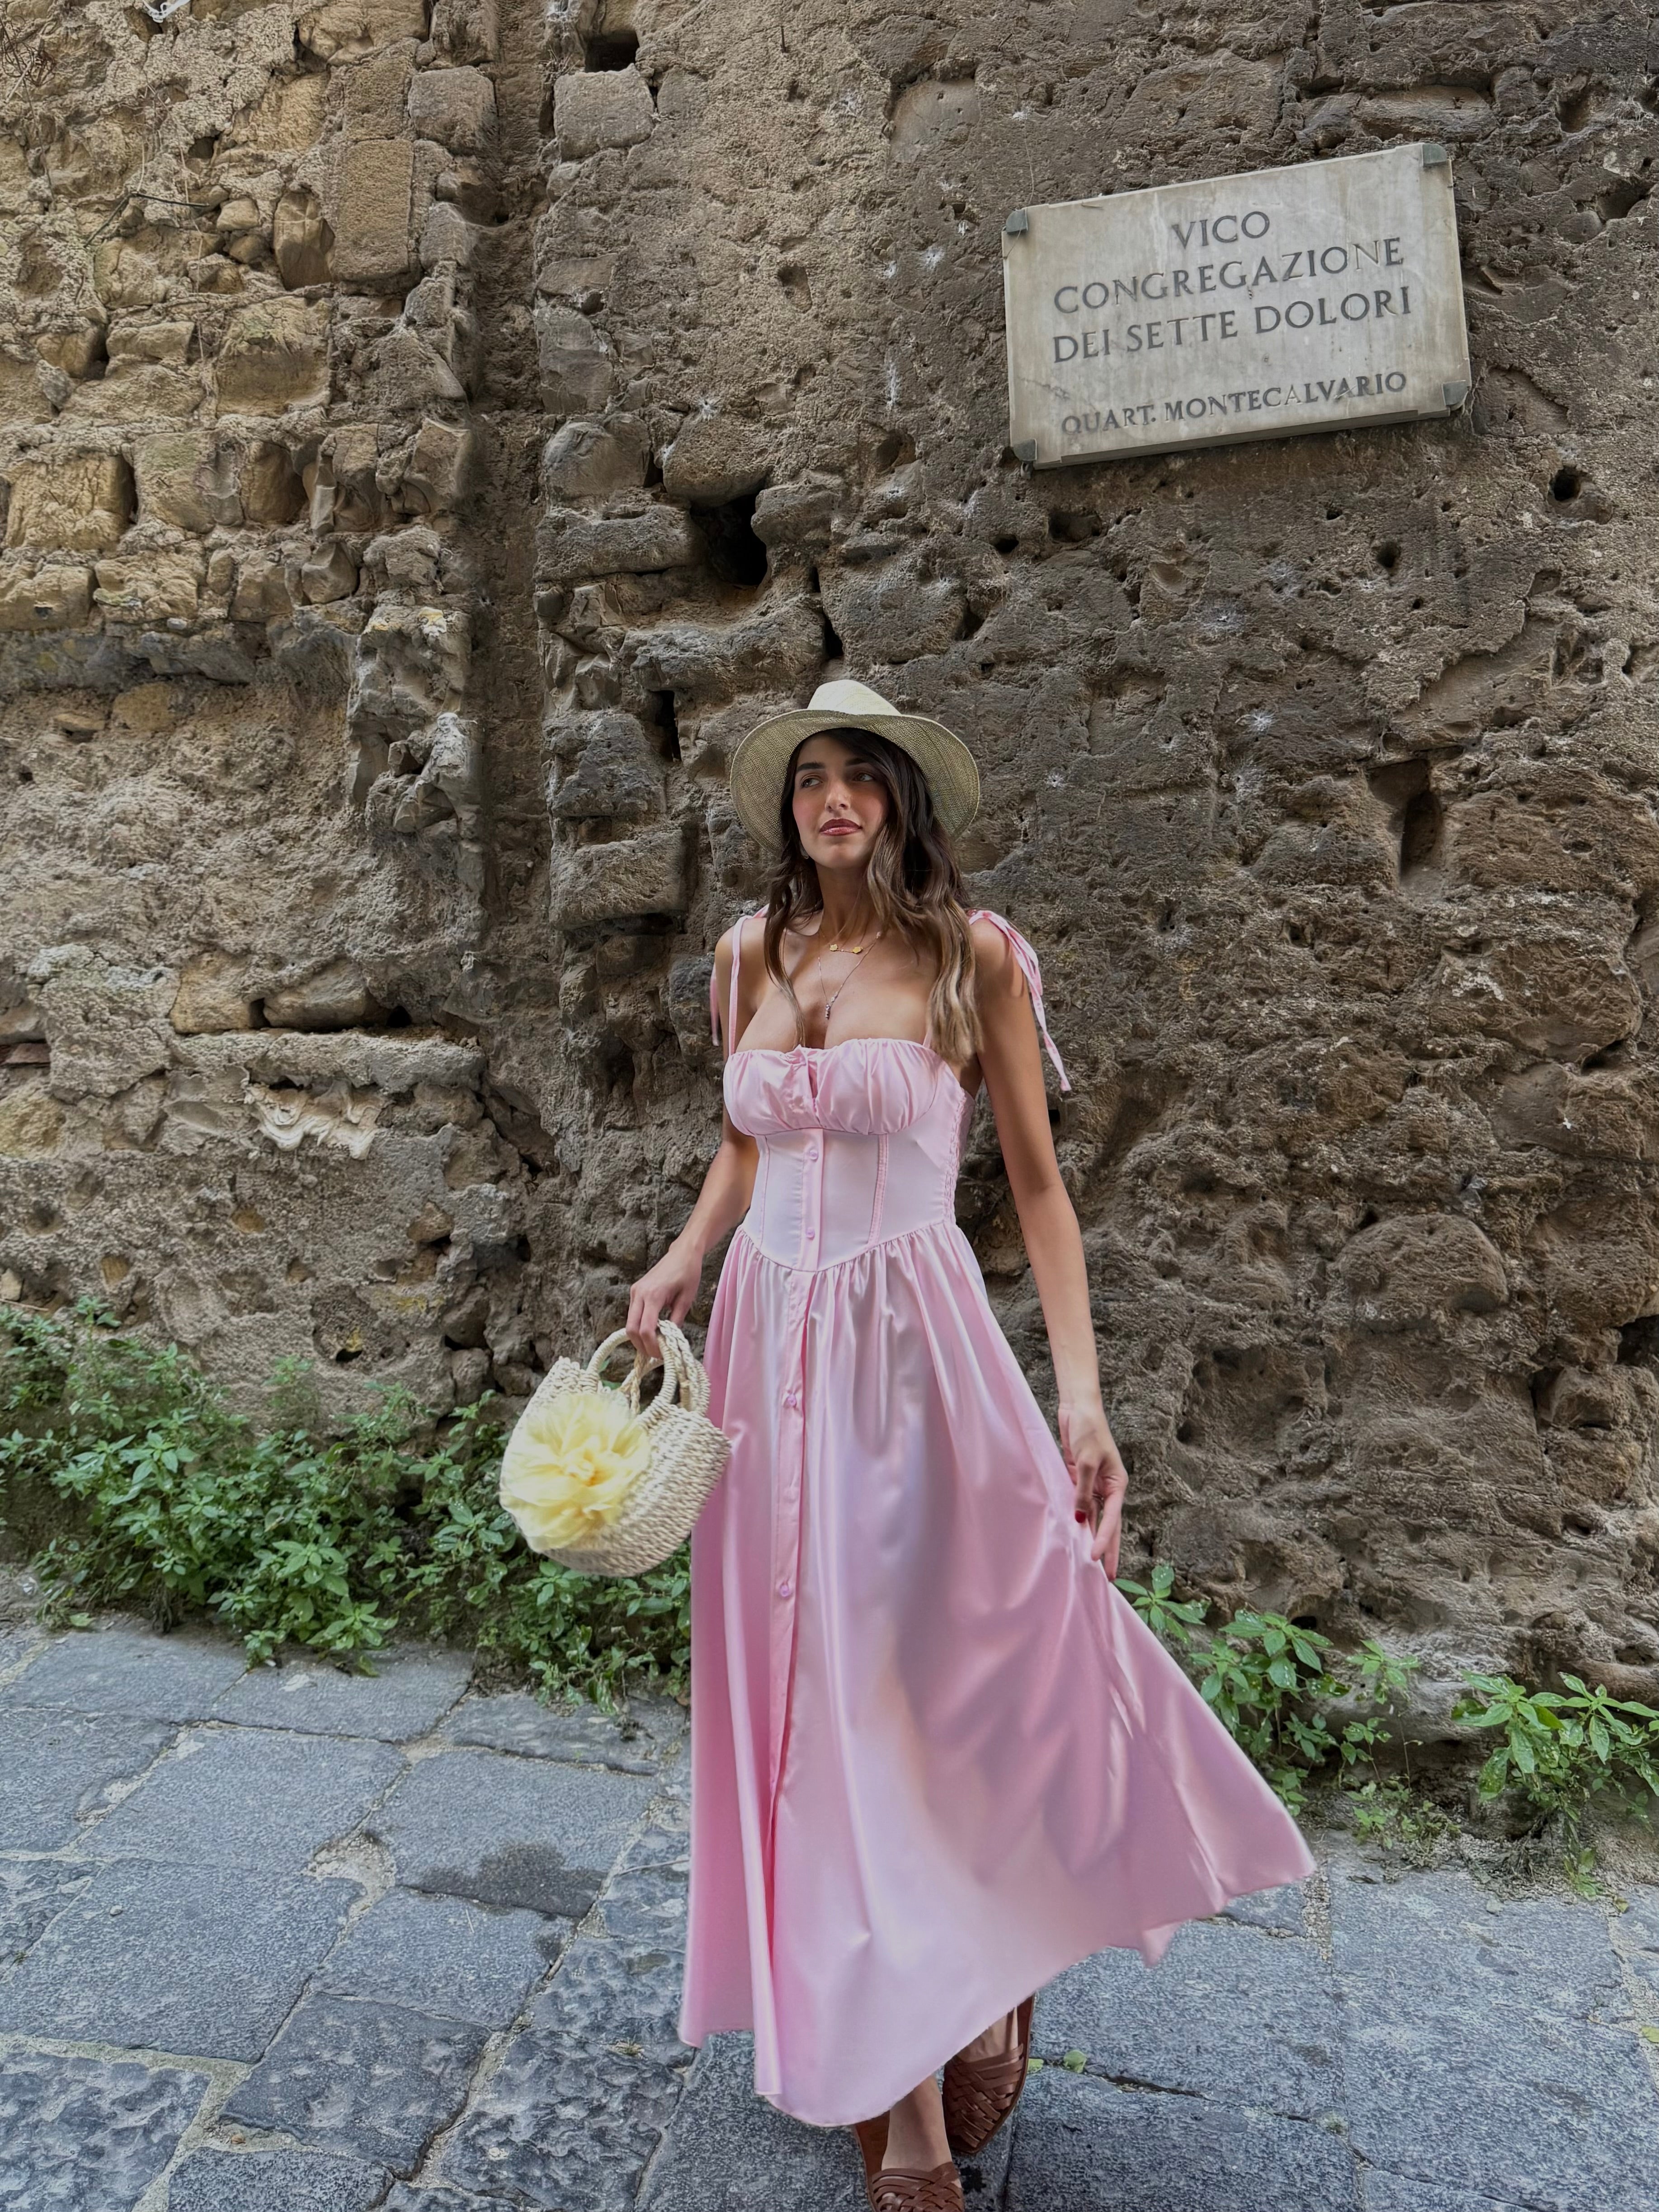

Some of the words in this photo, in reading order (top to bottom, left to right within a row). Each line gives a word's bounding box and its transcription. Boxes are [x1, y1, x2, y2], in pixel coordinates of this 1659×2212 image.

[1171, 211, 1270, 249] VICO
[1054, 237, 1404, 314] CONGREGAZIONE
[1053, 329, 1111, 362] DEI
[1126, 311, 1238, 353] SETTE
[1255, 286, 1411, 334] DOLORI
[1061, 403, 1156, 435] QUART.
[1164, 372, 1407, 421] MONTECALVARIO
